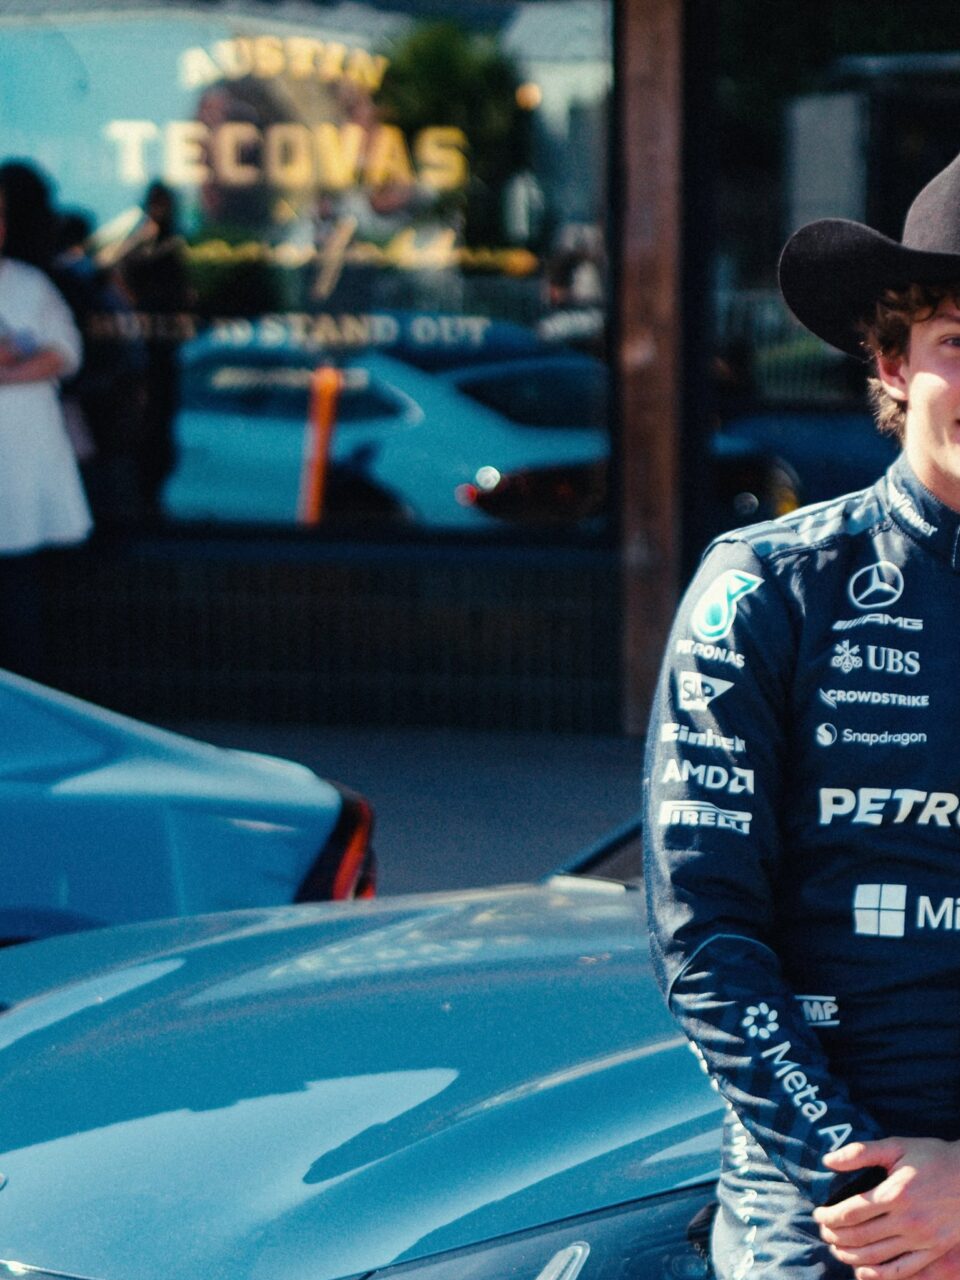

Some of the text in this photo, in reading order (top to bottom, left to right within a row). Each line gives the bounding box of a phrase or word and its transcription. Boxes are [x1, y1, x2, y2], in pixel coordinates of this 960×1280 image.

[179, 34, 389, 94] AUSTIN
[106, 119, 470, 191] TECOVAS
[258, 313, 400, 346] STAND
[411, 317, 491, 347] OUT
[861, 612, 923, 630] AMG
[867, 645, 921, 675] UBS
[683, 679, 716, 702] SAP
[825, 689, 930, 707] CROWDSTRIKE
[843, 728, 927, 746] Snapdragon
[661, 758, 730, 789] AMD
[658, 800, 752, 835] PIRELLI
[801, 1000, 839, 1021] MP
[761, 1040, 853, 1153] Meta A
